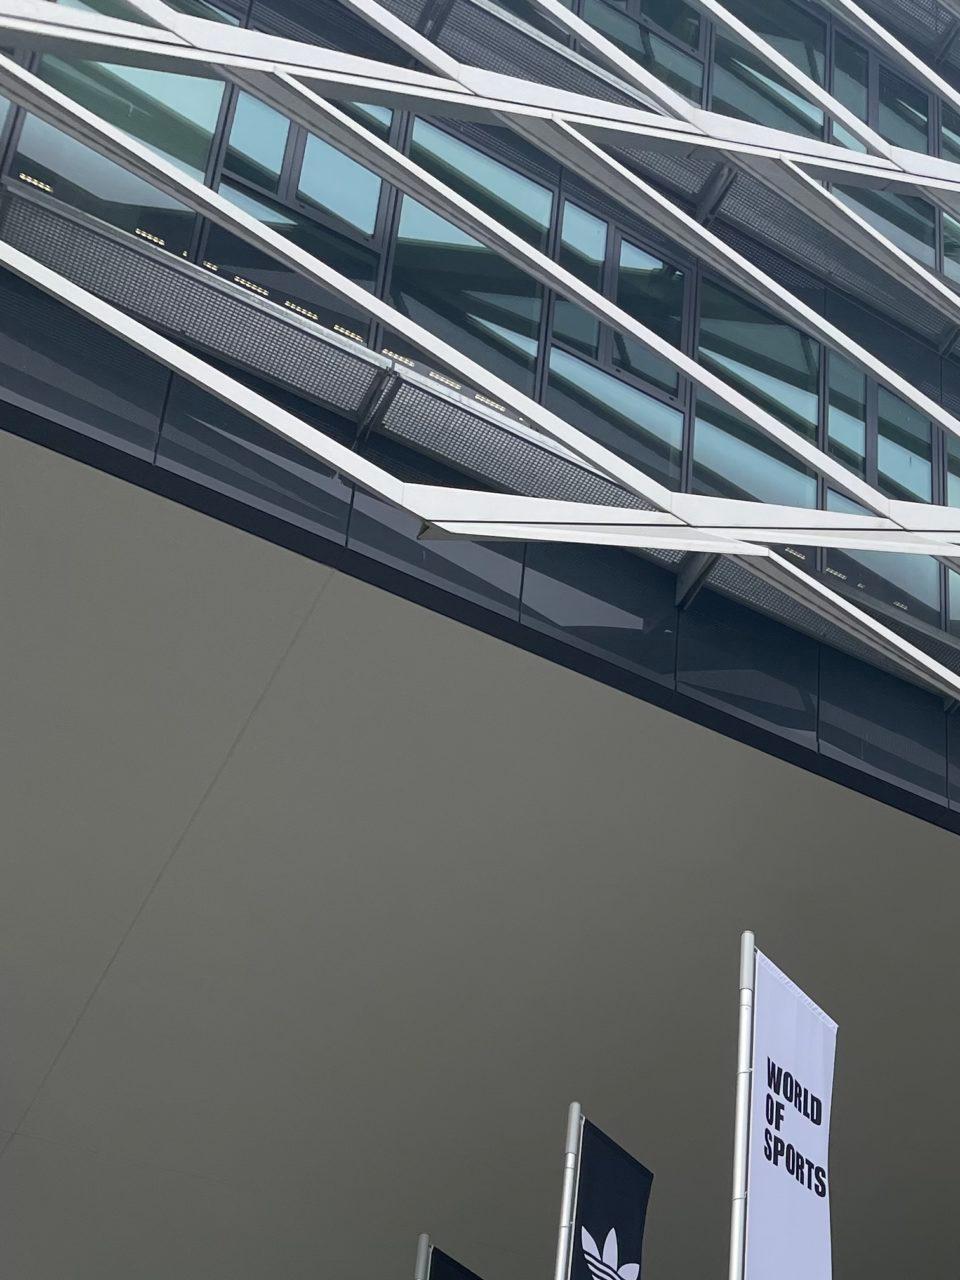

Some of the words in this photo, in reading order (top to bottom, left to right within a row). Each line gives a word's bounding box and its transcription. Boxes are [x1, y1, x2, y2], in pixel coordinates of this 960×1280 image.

[765, 1093, 785, 1132] OF
[767, 1056, 822, 1126] WORLD
[763, 1127, 827, 1198] SPORTS
